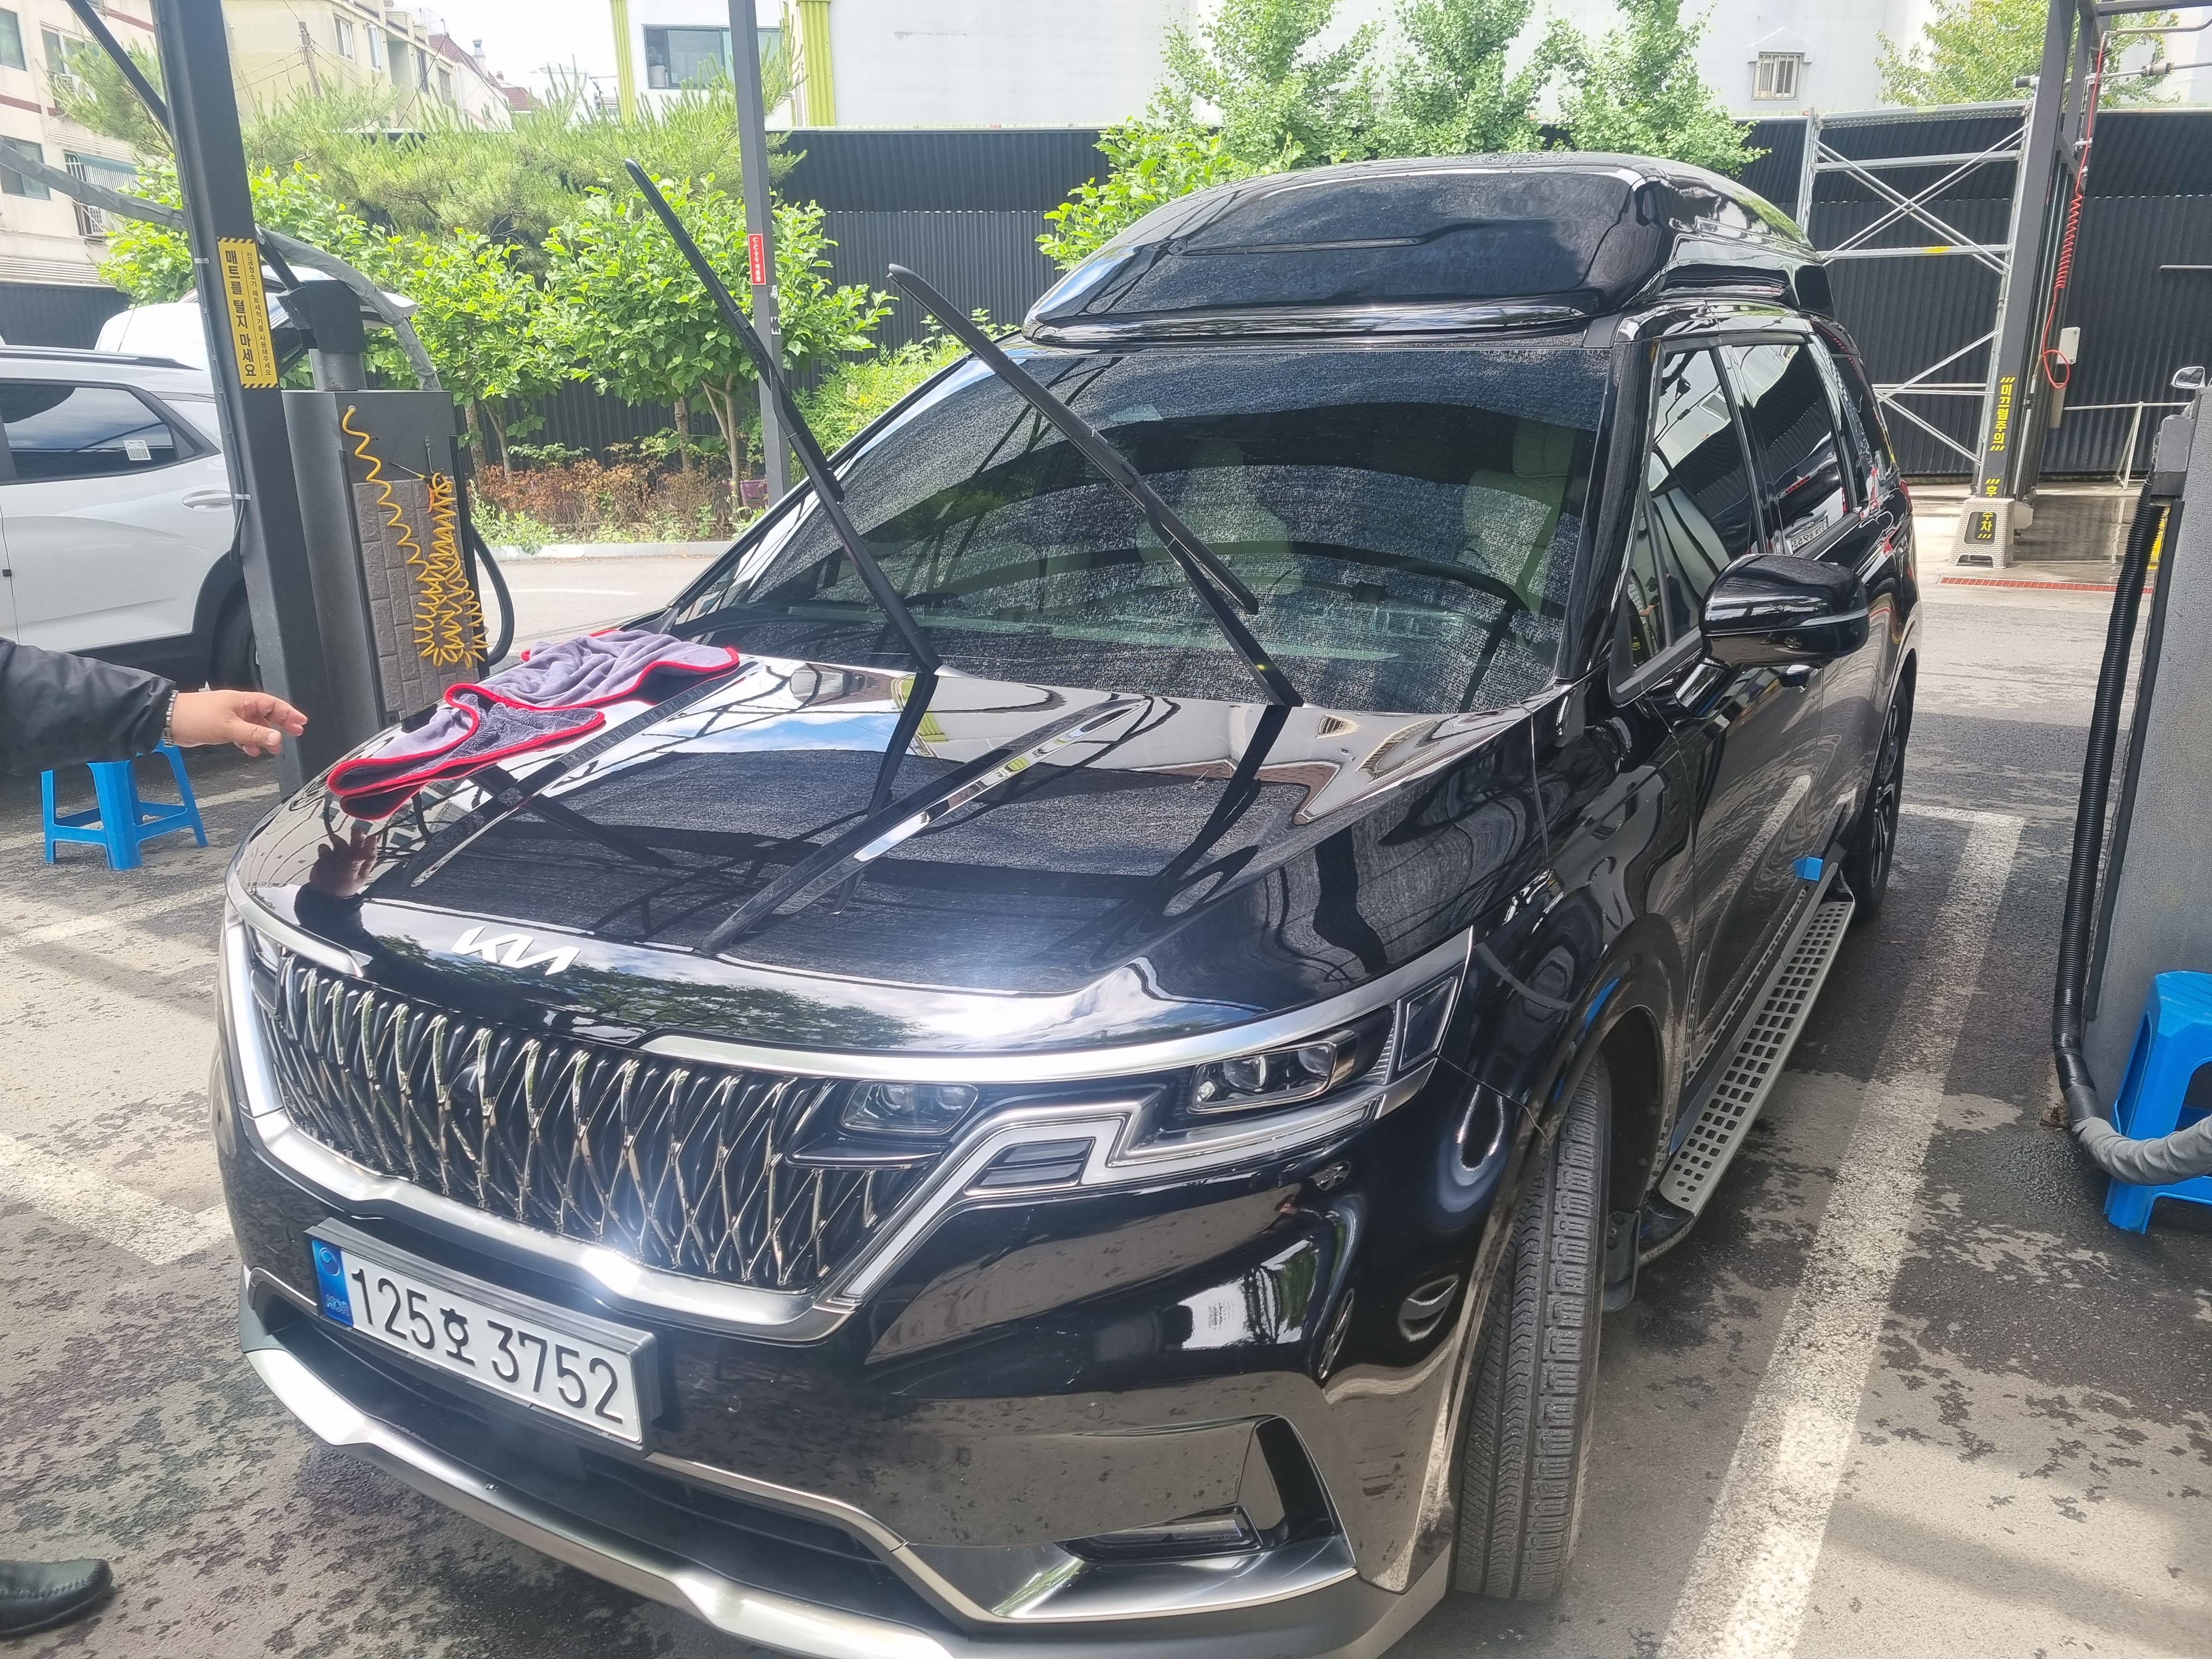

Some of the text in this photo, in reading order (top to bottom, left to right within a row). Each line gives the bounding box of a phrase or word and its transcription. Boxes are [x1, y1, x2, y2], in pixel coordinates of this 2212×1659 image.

[225, 250, 257, 376] 매트를 털지 마세요
[246, 252, 257, 287] 진공청소기
[259, 334, 272, 376] 사용해주세요
[451, 926, 581, 976] KIA
[325, 1294, 351, 1317] KOR
[351, 1268, 623, 1425] 125호 3752
